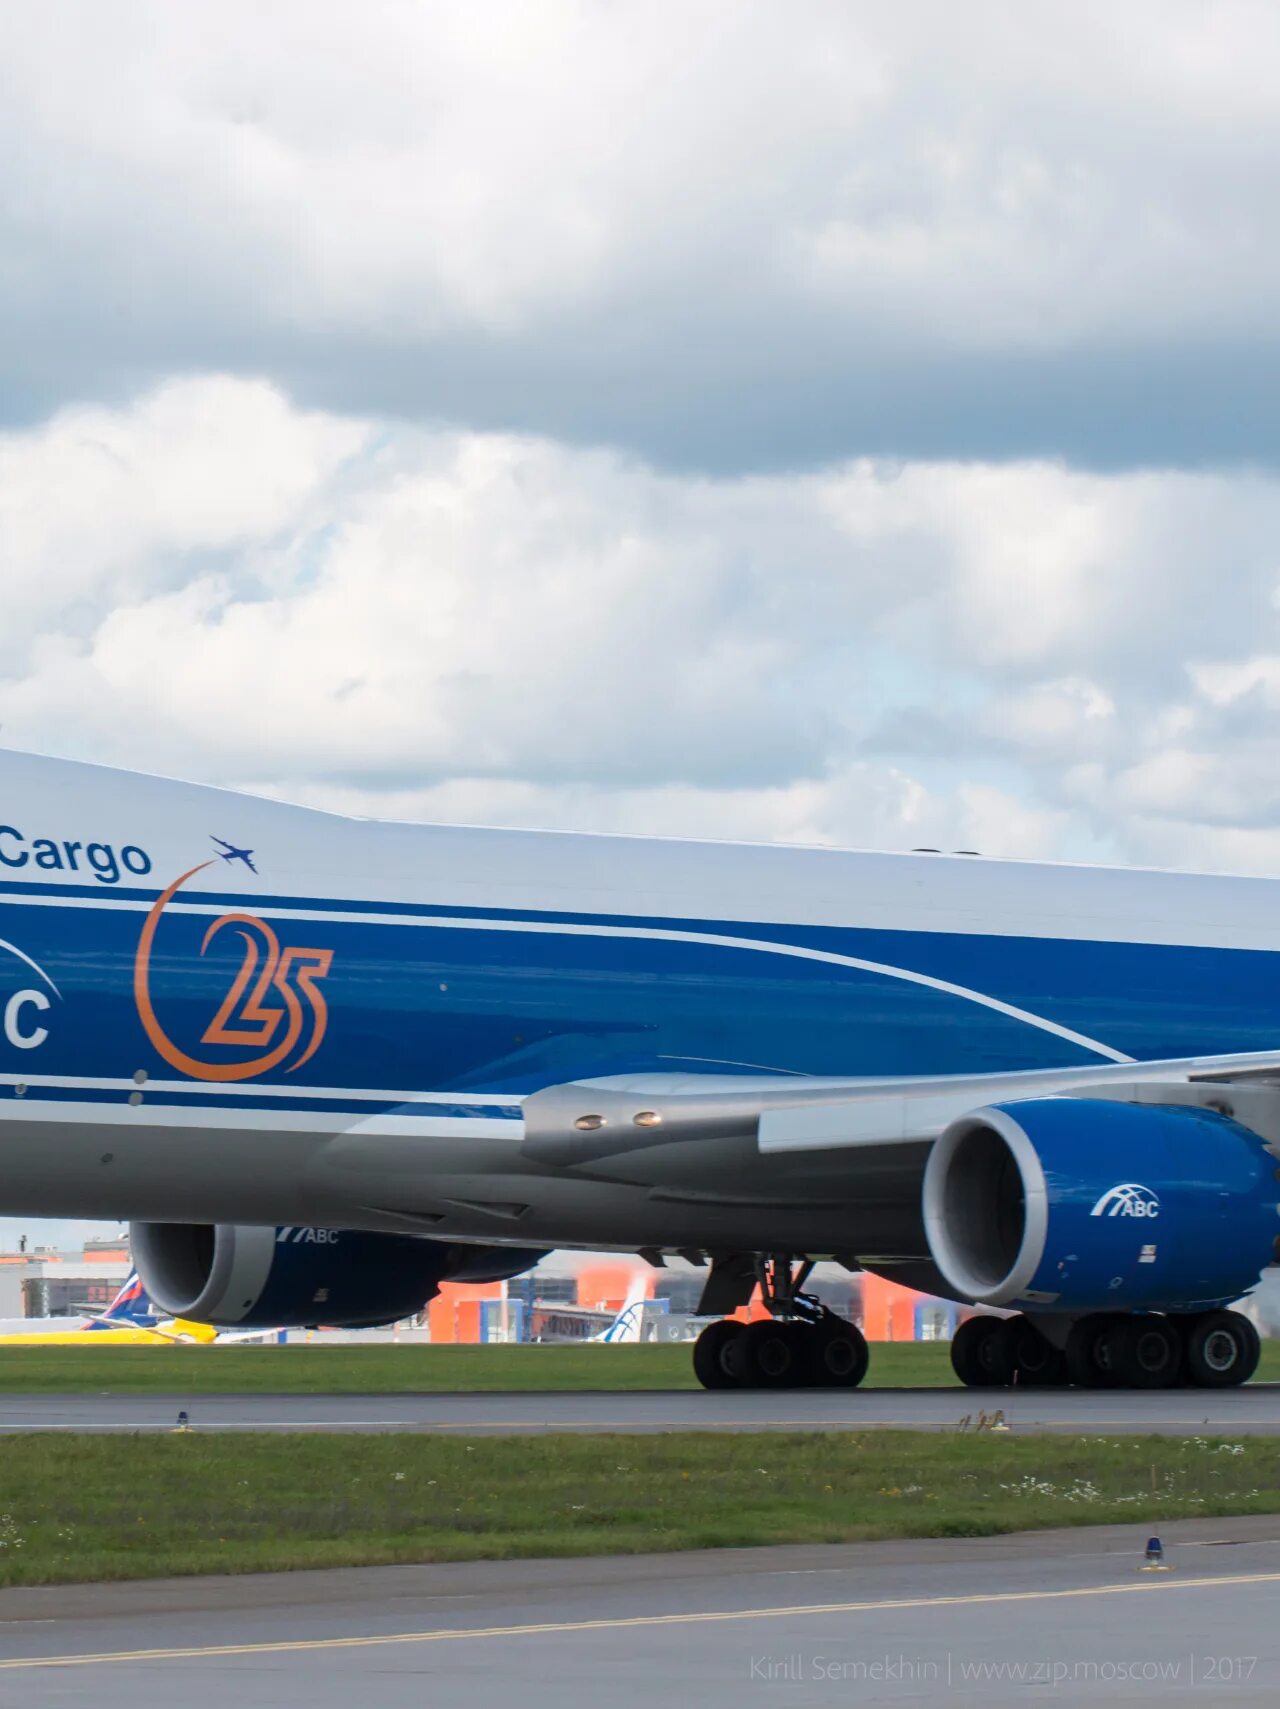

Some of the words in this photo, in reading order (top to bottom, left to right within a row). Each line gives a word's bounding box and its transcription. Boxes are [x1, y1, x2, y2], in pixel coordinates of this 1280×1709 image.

[199, 913, 335, 1074] 25
[1121, 1199, 1159, 1218] ABC
[304, 1227, 339, 1244] ABC
